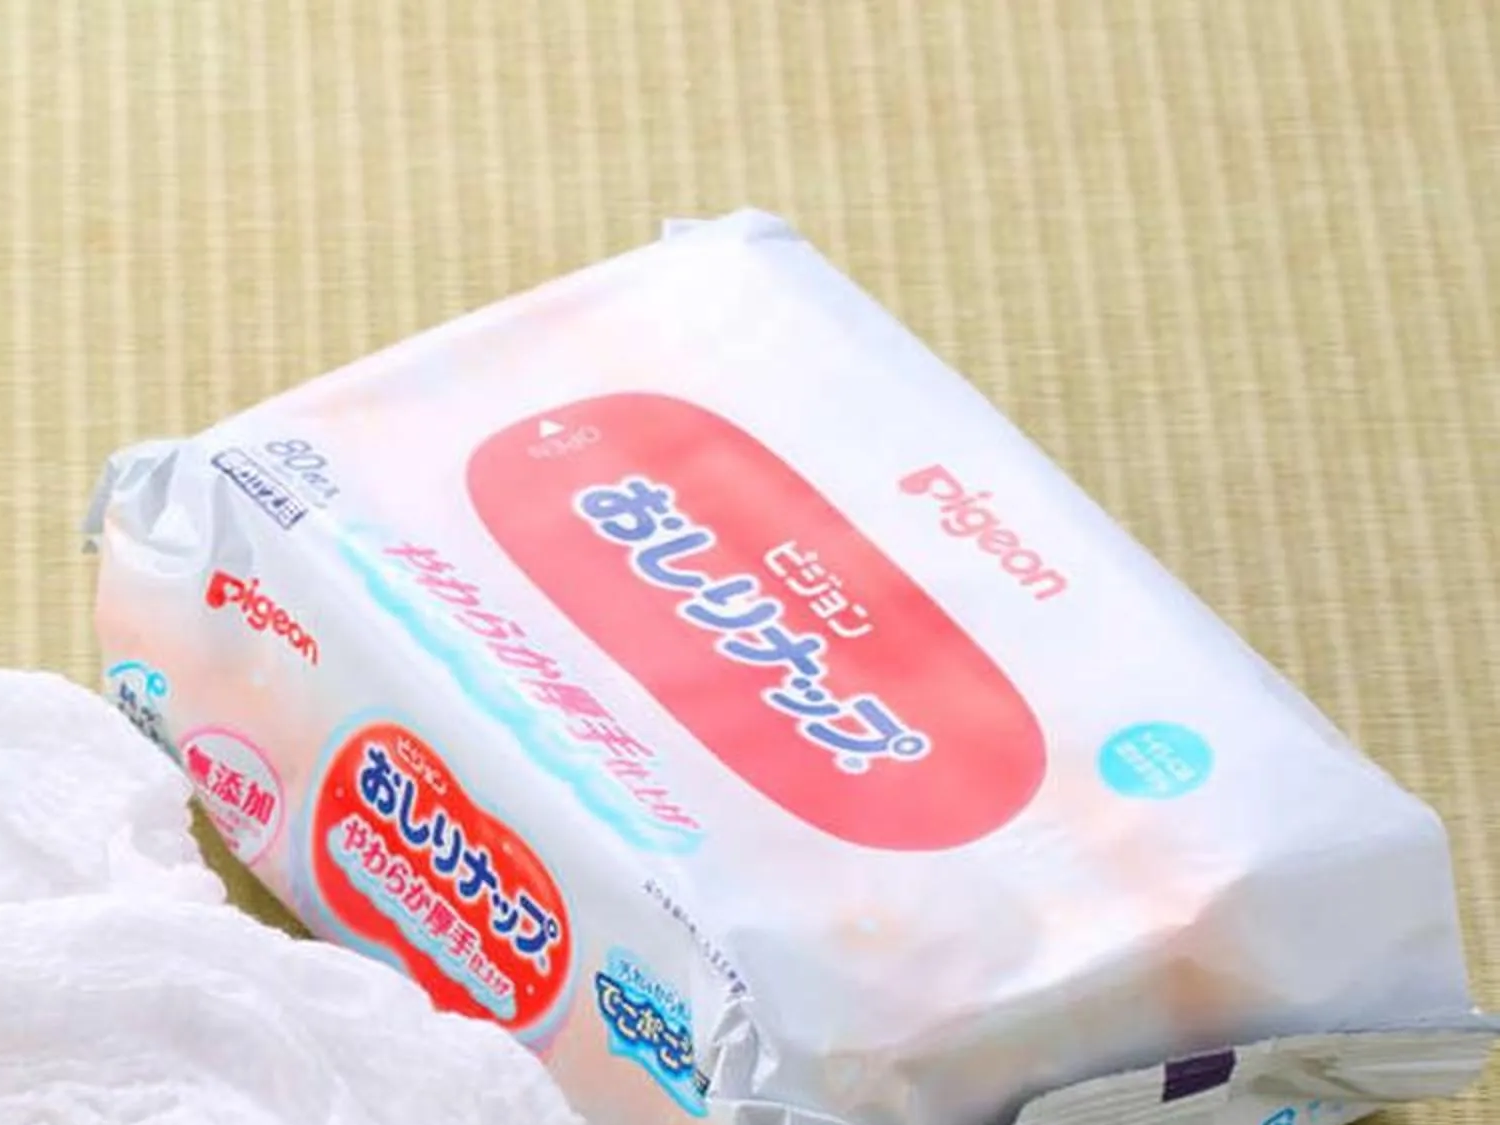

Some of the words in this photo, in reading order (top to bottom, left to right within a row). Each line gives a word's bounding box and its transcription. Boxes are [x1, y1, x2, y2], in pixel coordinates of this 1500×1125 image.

[575, 476, 928, 760] おしりナップ
[341, 815, 514, 998] やわらか厚手仕上げ
[359, 746, 559, 955] おしりナップ
